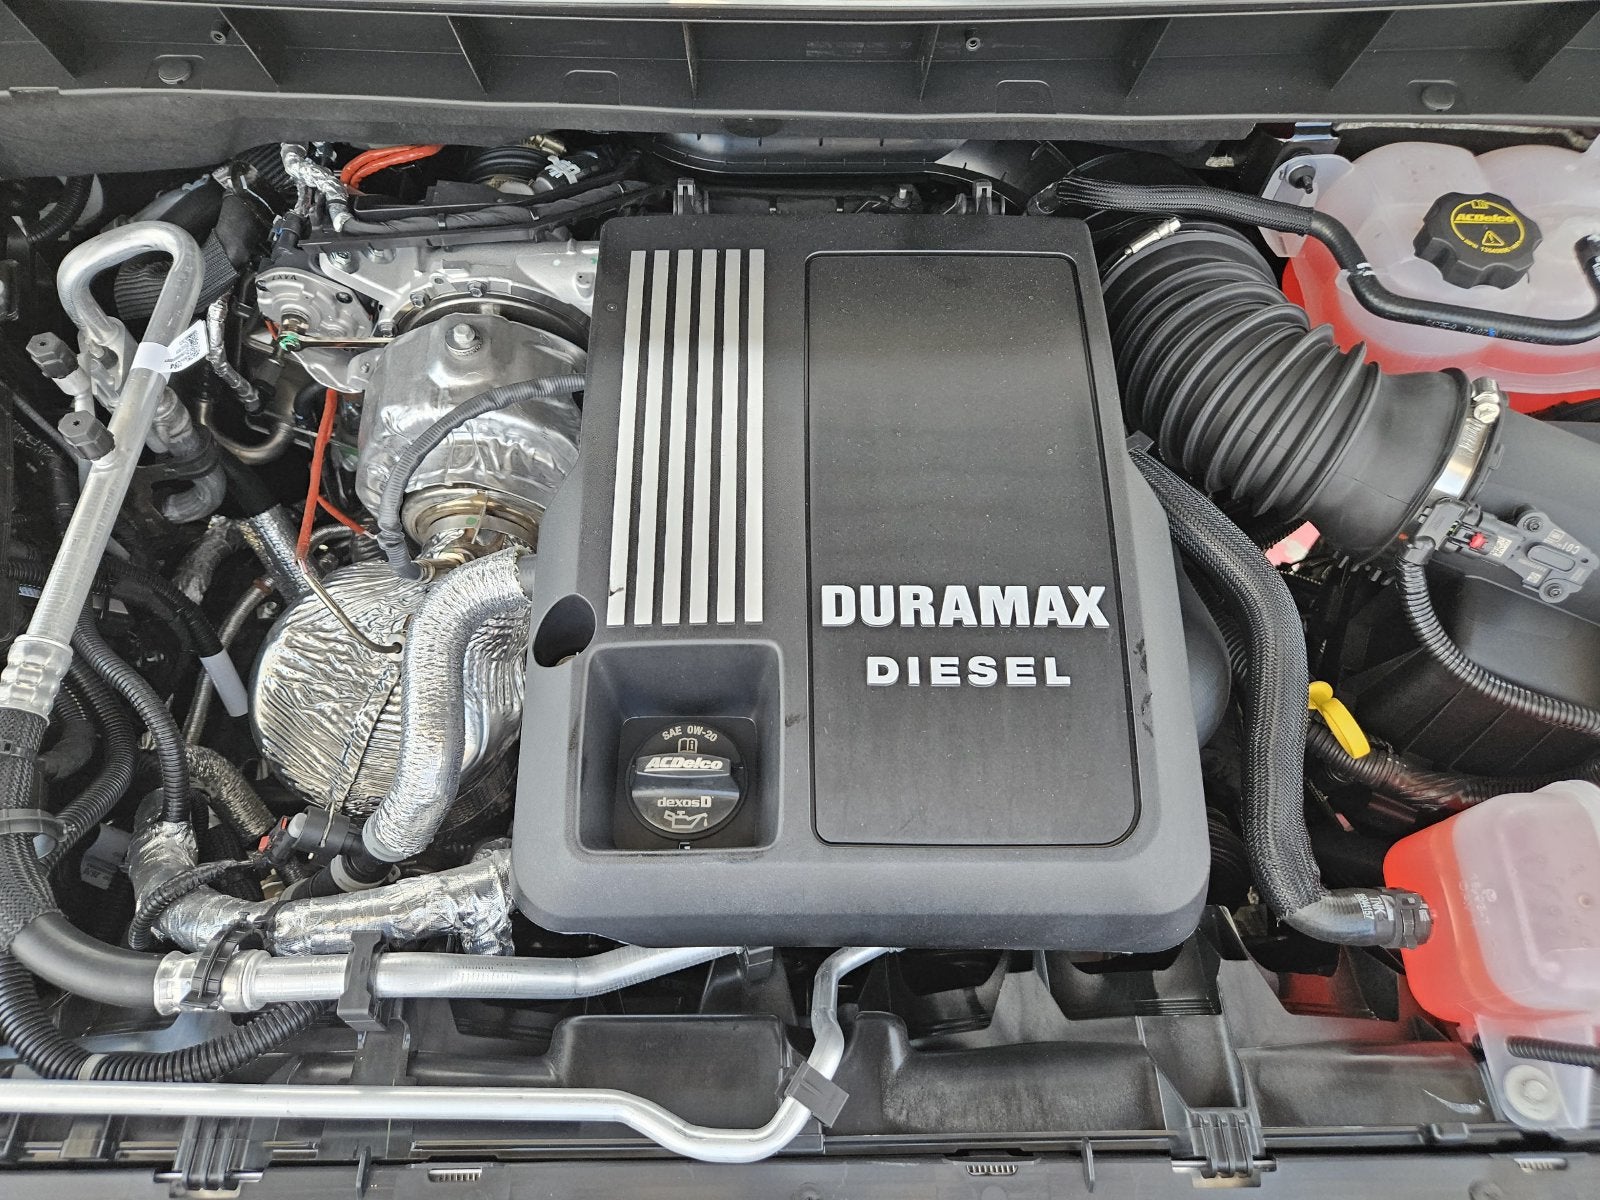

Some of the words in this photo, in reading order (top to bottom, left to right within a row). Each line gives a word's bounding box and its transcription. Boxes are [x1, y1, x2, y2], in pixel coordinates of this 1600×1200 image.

[1454, 213, 1516, 223] ACDelco
[821, 584, 1110, 628] DURAMAX
[866, 655, 1071, 686] DIESEL
[662, 726, 682, 740] SAE
[687, 725, 718, 742] 0W-20
[644, 756, 724, 771] ACDelco
